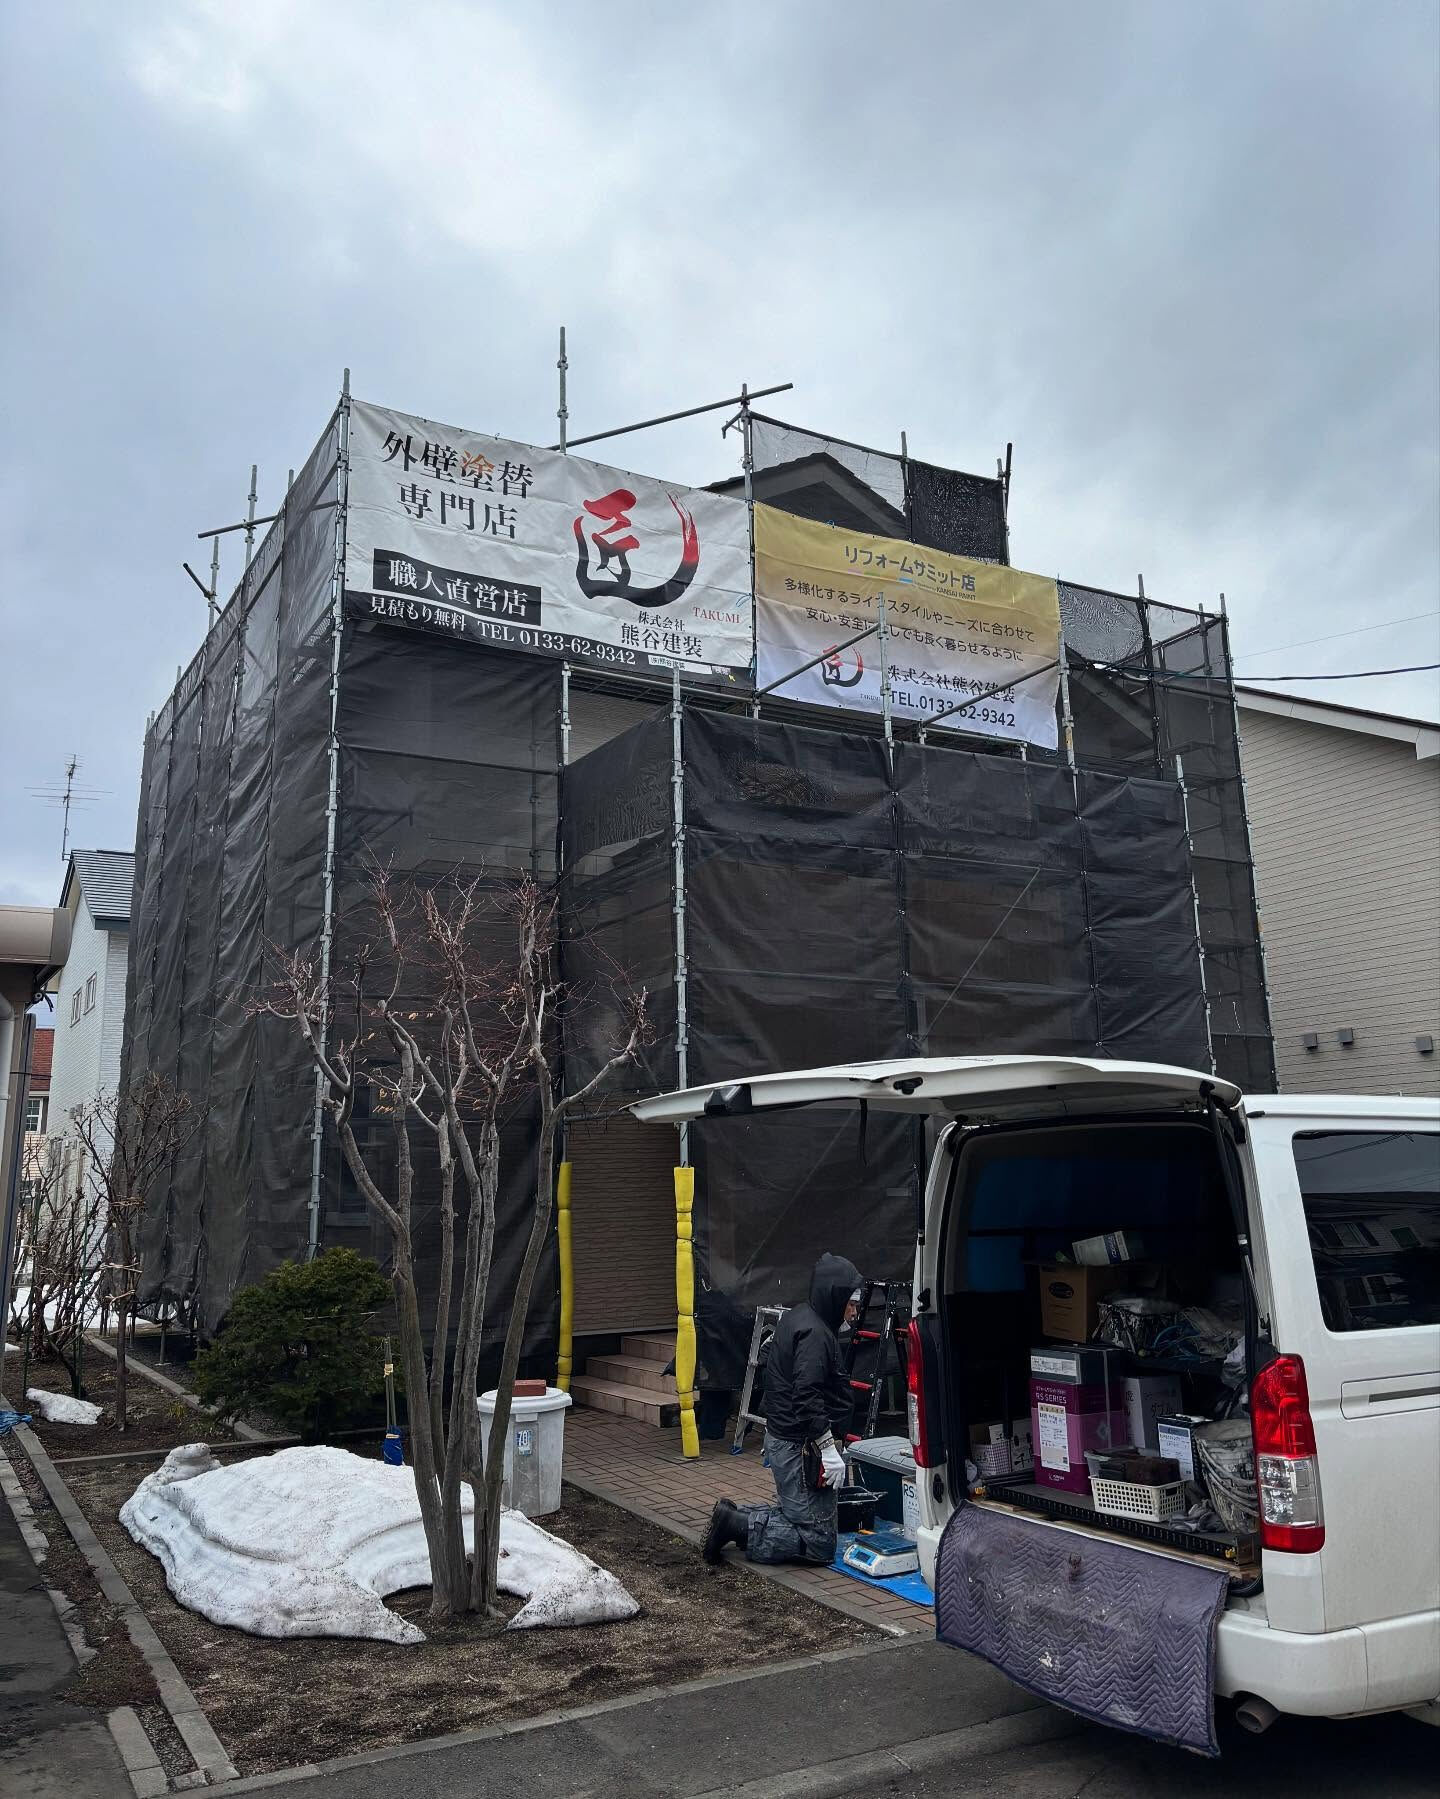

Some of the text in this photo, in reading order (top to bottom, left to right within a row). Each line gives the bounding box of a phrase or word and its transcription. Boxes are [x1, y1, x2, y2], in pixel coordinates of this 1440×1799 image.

[381, 430, 534, 499] 外壁塗替
[396, 482, 518, 539] 専門店
[388, 559, 528, 617] 職人直営店
[845, 545, 976, 592] リフォームサミット店
[369, 596, 636, 665] 見積もり無料 TEL 0133-62-9342
[621, 622, 703, 658] 熊谷建装
[638, 610, 686, 632] 株式会社
[692, 606, 740, 624] TAKUMI
[805, 607, 1024, 662] 安心・安全にしでも長く暮らせるように
[903, 1483, 915, 1499] RS
